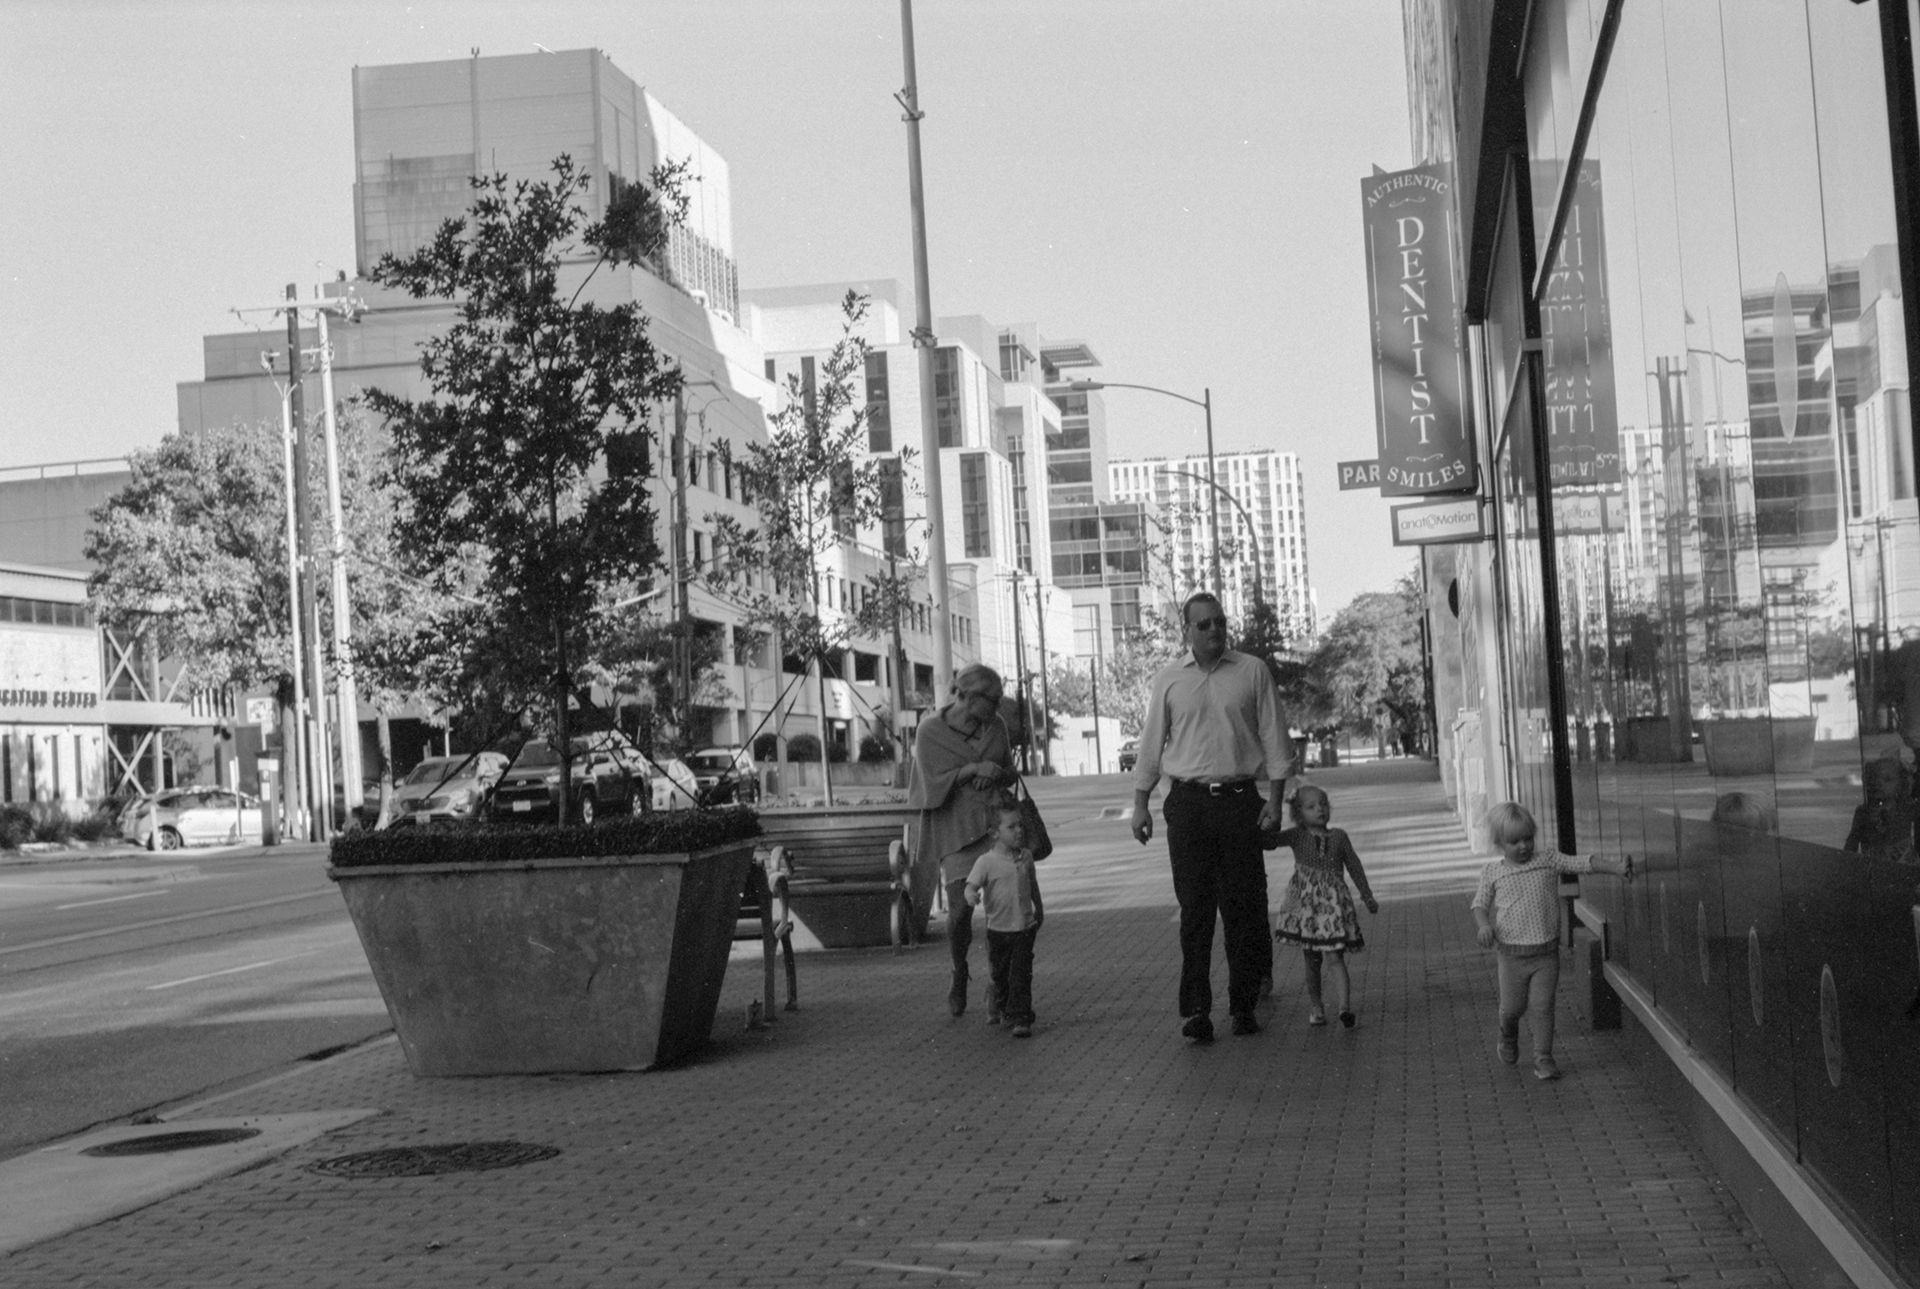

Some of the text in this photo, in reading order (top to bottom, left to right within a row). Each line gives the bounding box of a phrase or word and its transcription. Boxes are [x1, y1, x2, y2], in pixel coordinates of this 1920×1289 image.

[1367, 174, 1448, 208] AUTHENTIC
[1396, 216, 1436, 445] DENTIST
[1342, 464, 1380, 484] PAR
[1387, 459, 1466, 488] SMILES
